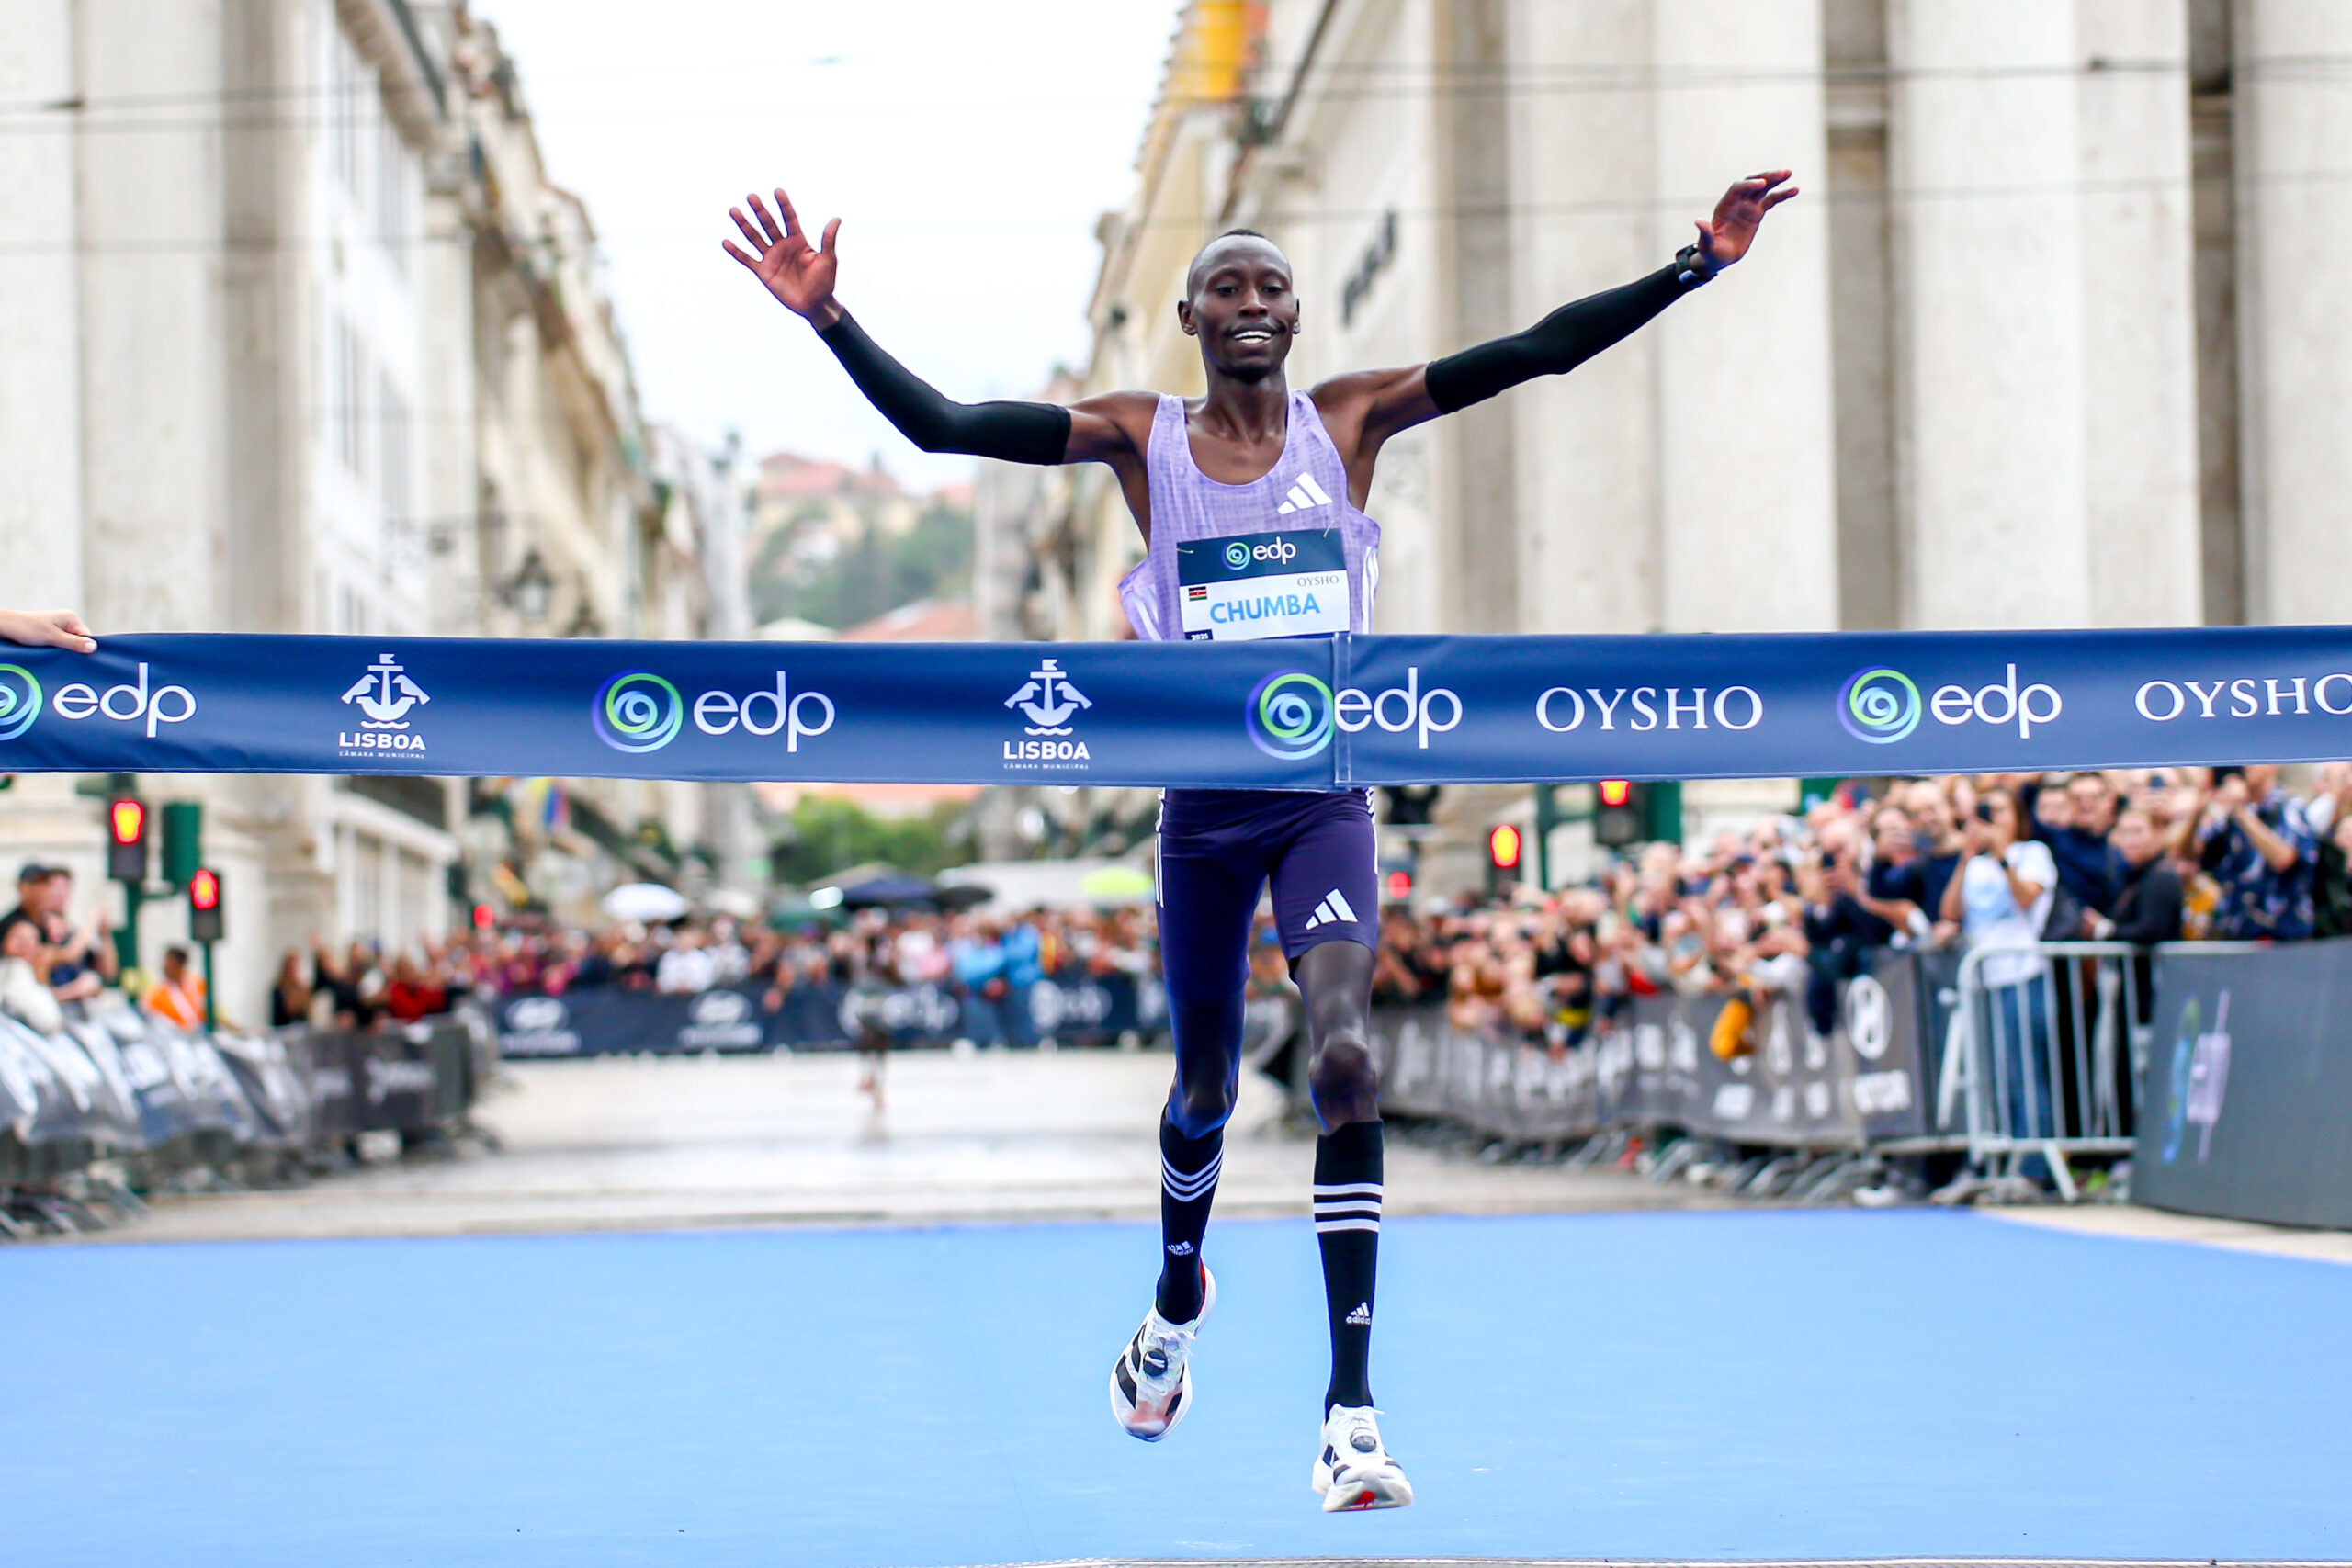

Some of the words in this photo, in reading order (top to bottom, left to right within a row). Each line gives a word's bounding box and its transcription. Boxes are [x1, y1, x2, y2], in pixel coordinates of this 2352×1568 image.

[1252, 536, 1296, 565] edp
[1296, 575, 1340, 588] OYSHO
[1210, 592, 1320, 624] CHUMBA
[1191, 633, 1209, 641] 2025
[52, 662, 197, 738] edp
[693, 670, 835, 753] edp
[1334, 667, 1463, 749] edp
[1535, 685, 1763, 732] OYSHO
[1930, 662, 2062, 739] edp
[2134, 673, 2352, 721] OYSHO
[339, 732, 426, 750] LISBOA
[1003, 740, 1091, 760] LISBOA
